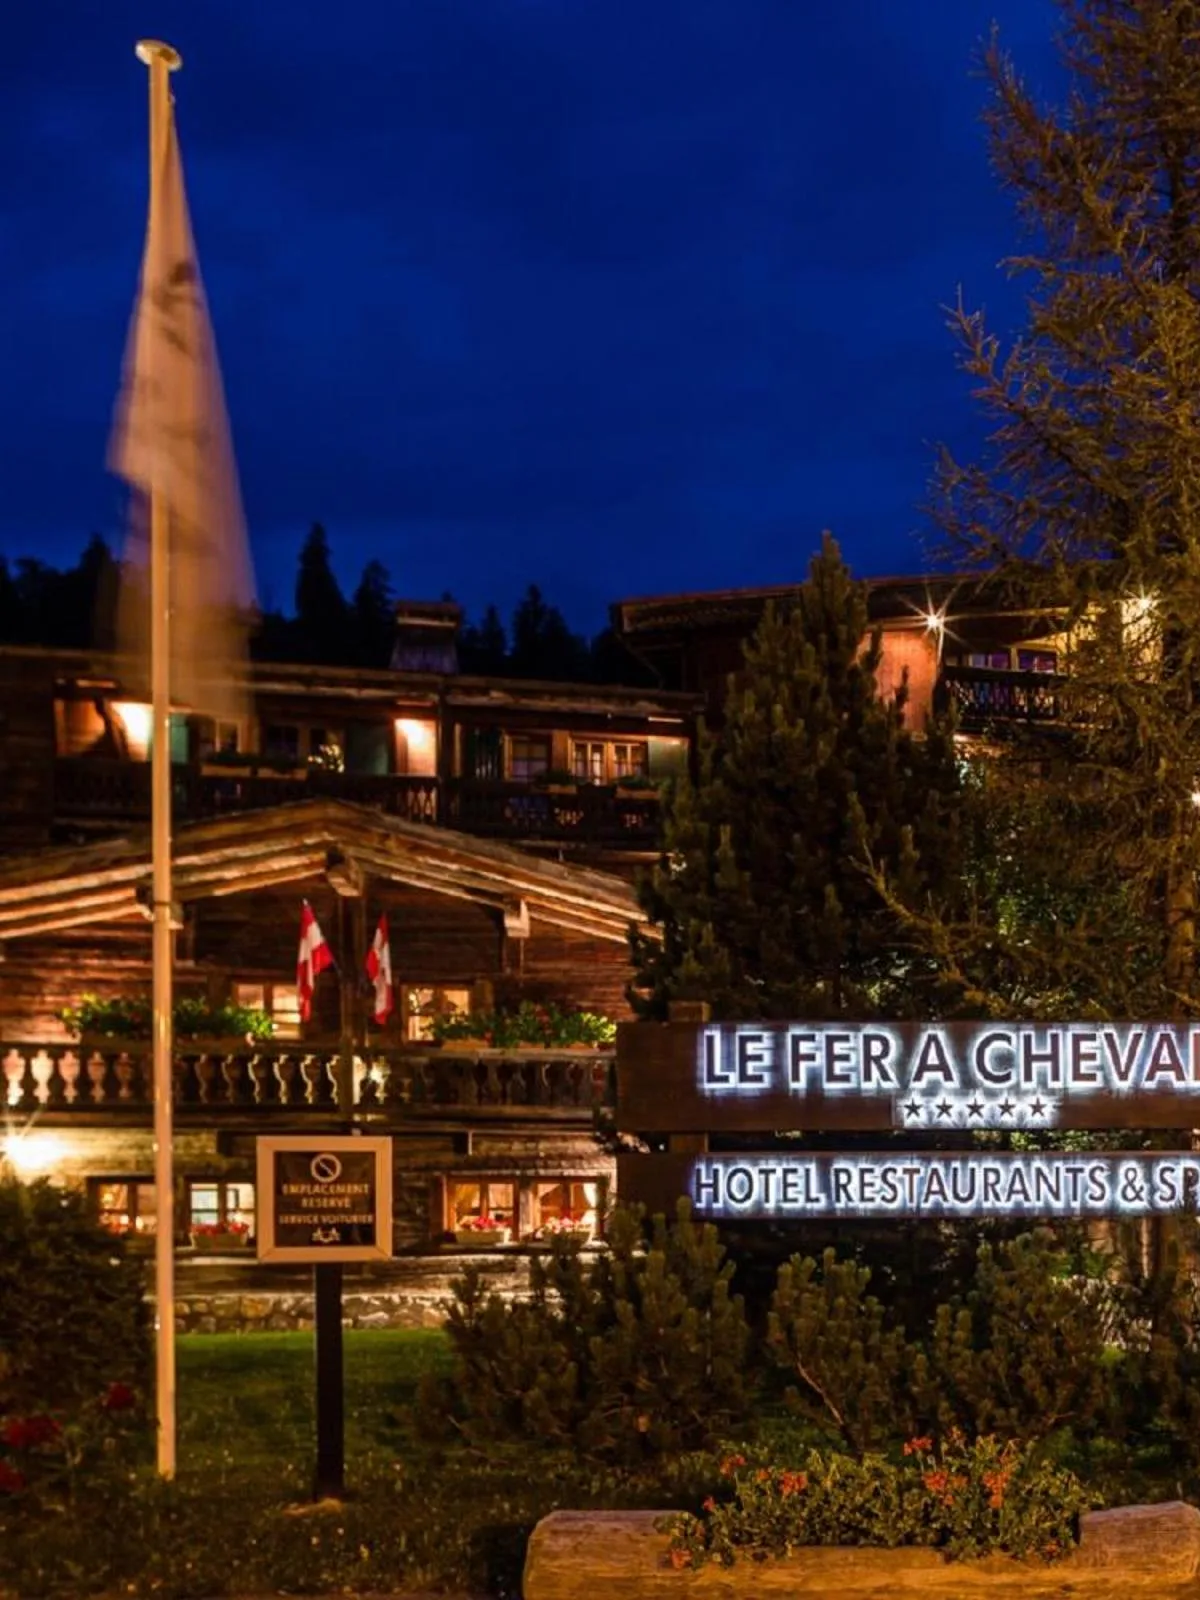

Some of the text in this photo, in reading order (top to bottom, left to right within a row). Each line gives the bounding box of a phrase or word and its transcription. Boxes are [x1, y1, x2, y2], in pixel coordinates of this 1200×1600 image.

[703, 1031, 768, 1086] LE
[788, 1031, 896, 1086] FER
[910, 1030, 956, 1085] A
[282, 1183, 370, 1195] EMPLACEMENT
[694, 1165, 822, 1205] HOTEL
[832, 1165, 1107, 1205] RESTAURANTS
[1119, 1165, 1146, 1203] &
